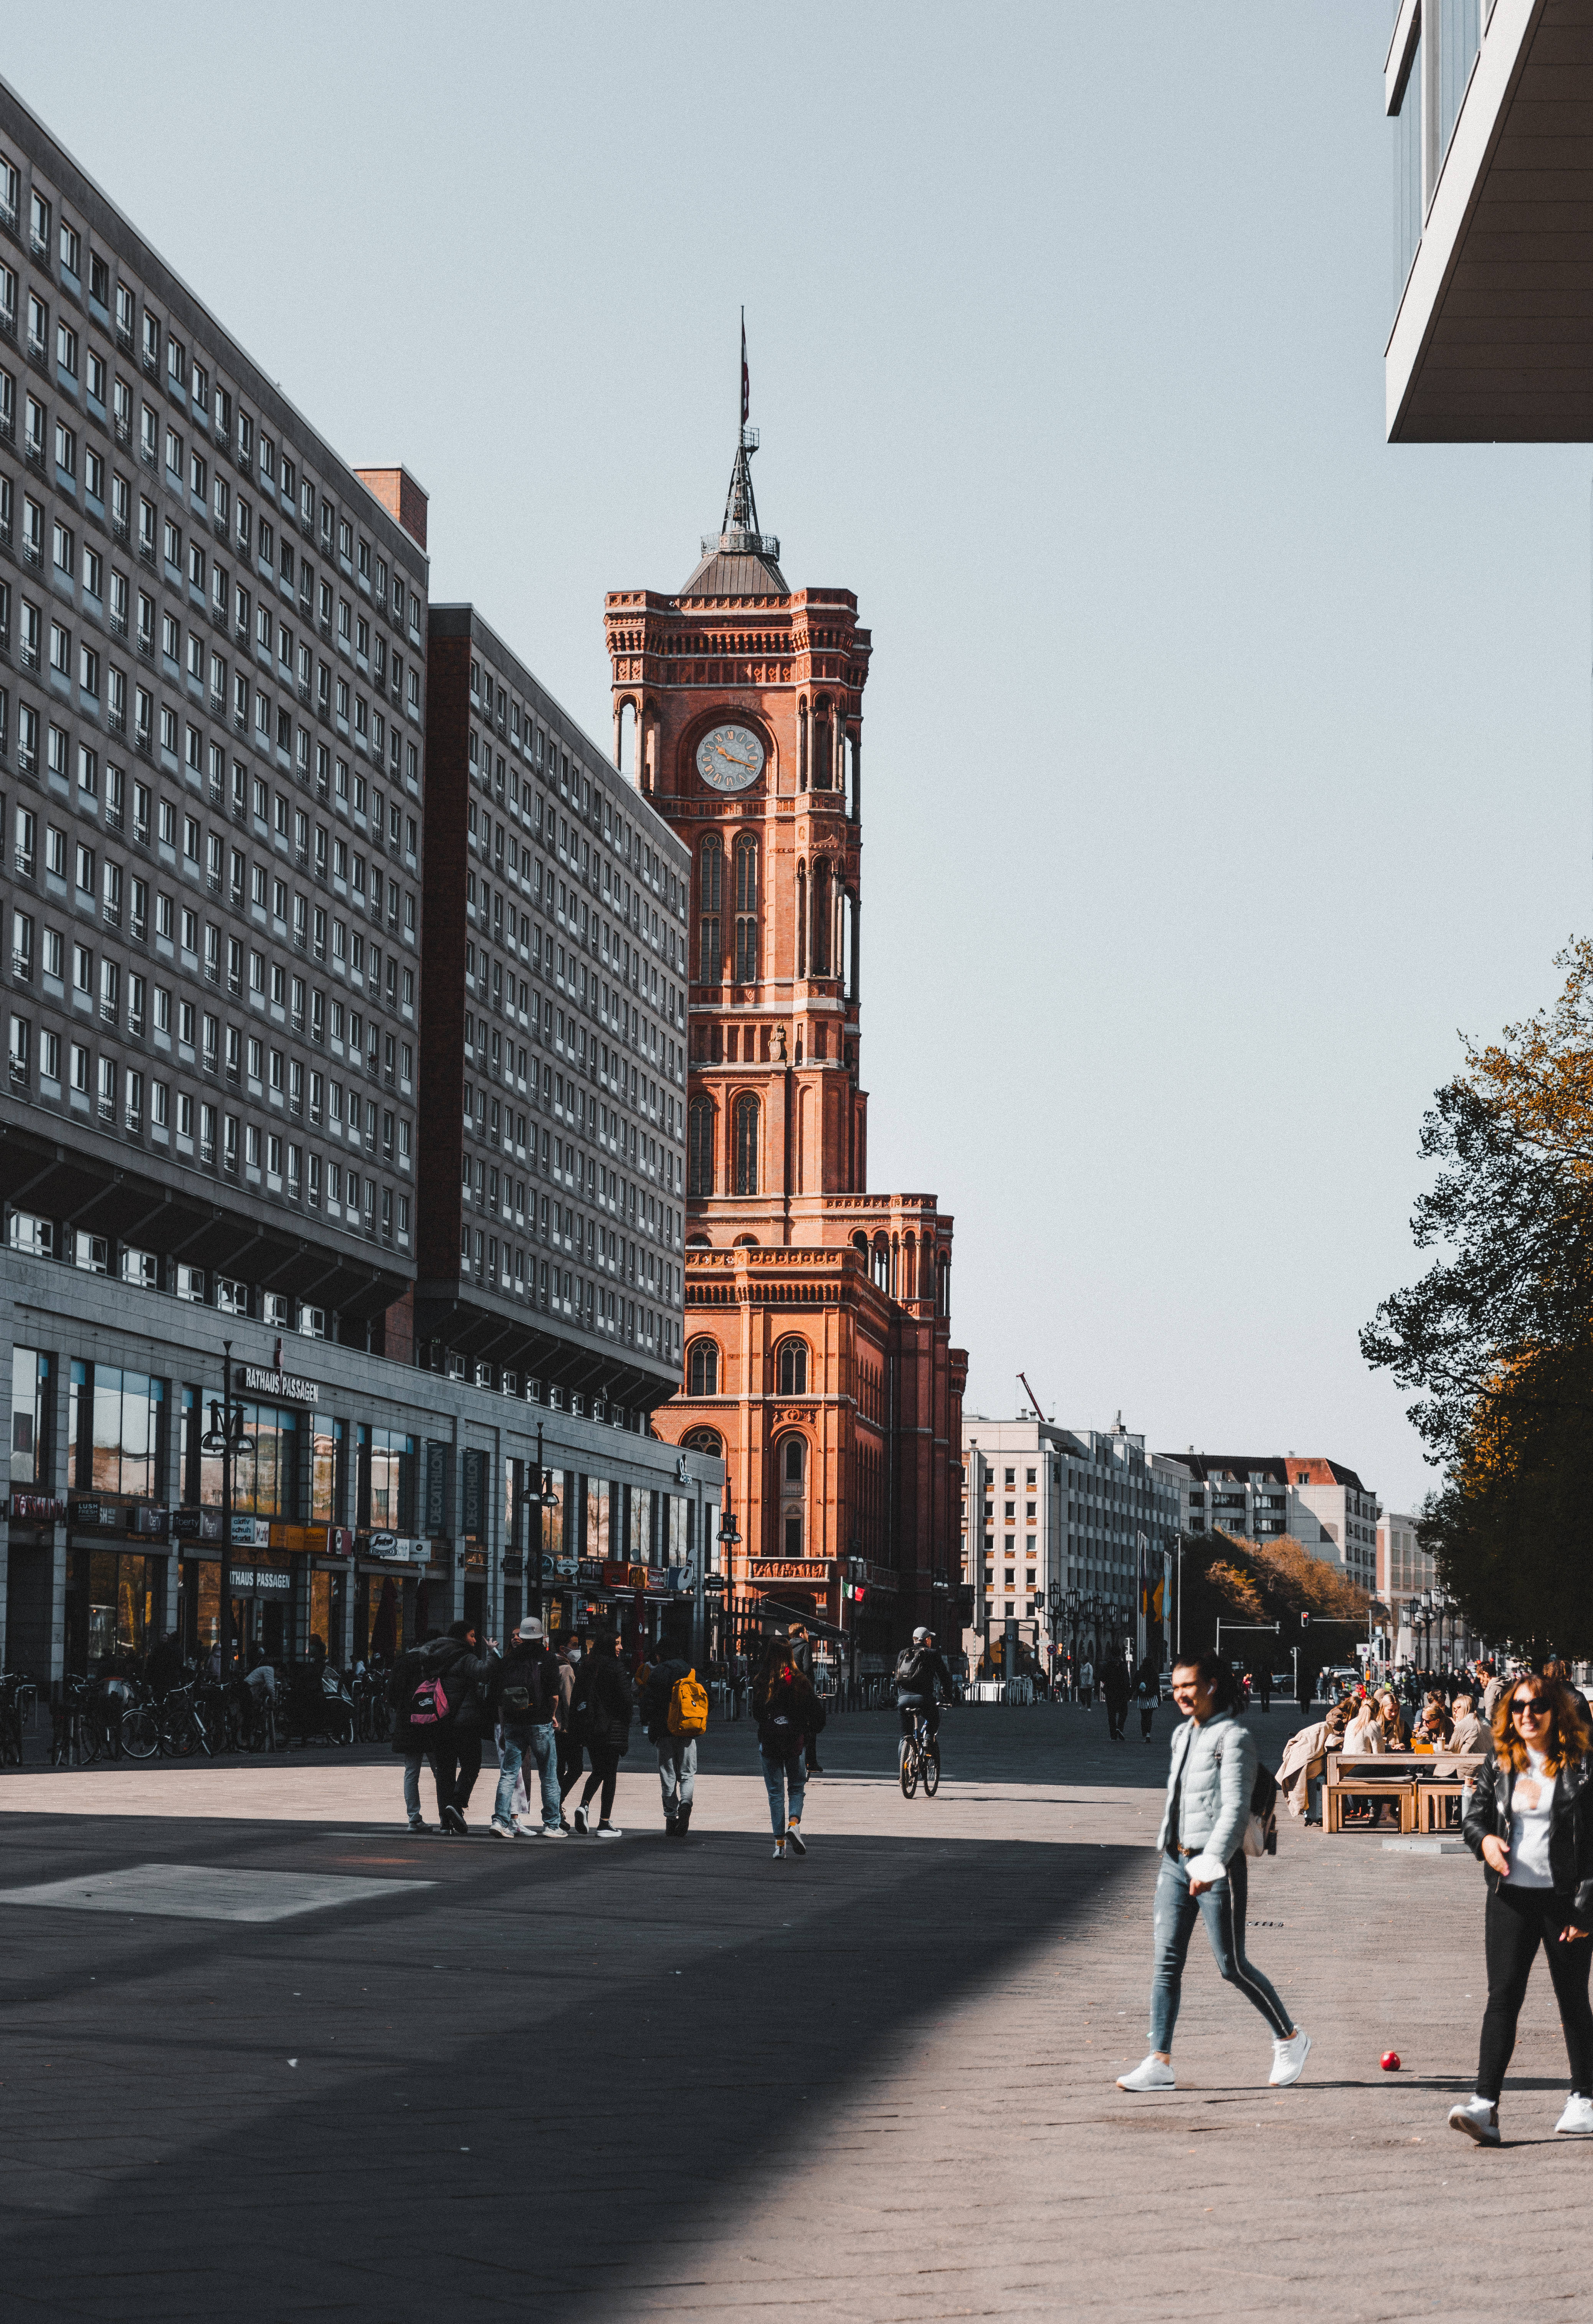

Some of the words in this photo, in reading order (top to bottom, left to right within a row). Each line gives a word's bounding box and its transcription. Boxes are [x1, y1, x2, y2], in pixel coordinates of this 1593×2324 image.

[246, 1368, 279, 1394] RATHAUS
[283, 1377, 319, 1403] PASSAGEN
[430, 1448, 443, 1523] DECATHLON
[466, 1454, 478, 1526] DECATHLON
[230, 1571, 254, 1586] THAUS
[257, 1573, 290, 1588] PASSAGEN
